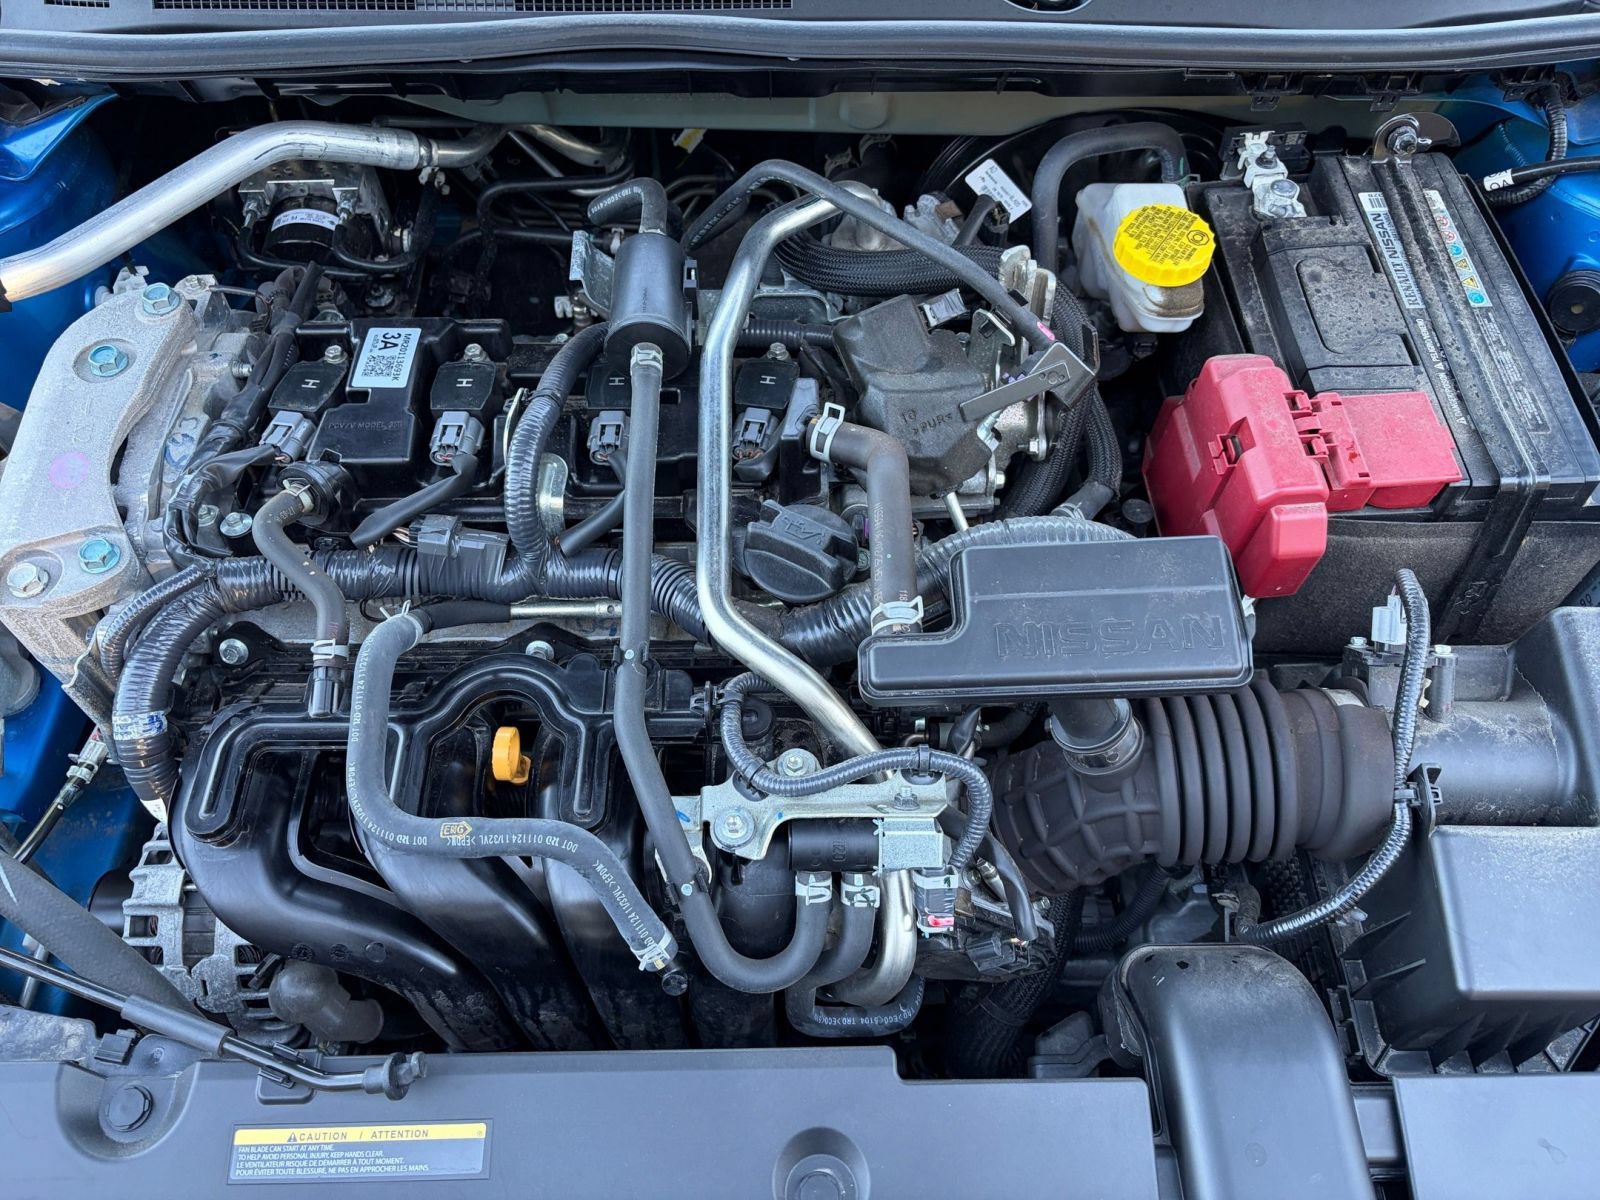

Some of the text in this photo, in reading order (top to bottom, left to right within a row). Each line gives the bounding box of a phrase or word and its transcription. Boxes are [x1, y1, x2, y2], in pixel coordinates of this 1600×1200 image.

[1370, 213, 1401, 259] NISSAN
[1391, 262, 1421, 306] RENAULT
[378, 332, 402, 351] 3A
[993, 614, 1225, 659] NISSAN
[368, 822, 394, 840] 011124
[444, 825, 464, 835] ENG
[512, 834, 542, 844] 011124
[412, 836, 428, 846] DOT
[562, 839, 578, 852] DOT
[628, 912, 648, 938] 011124
[299, 1132, 348, 1142] CAUTION
[370, 1129, 429, 1139] ATTENTION
